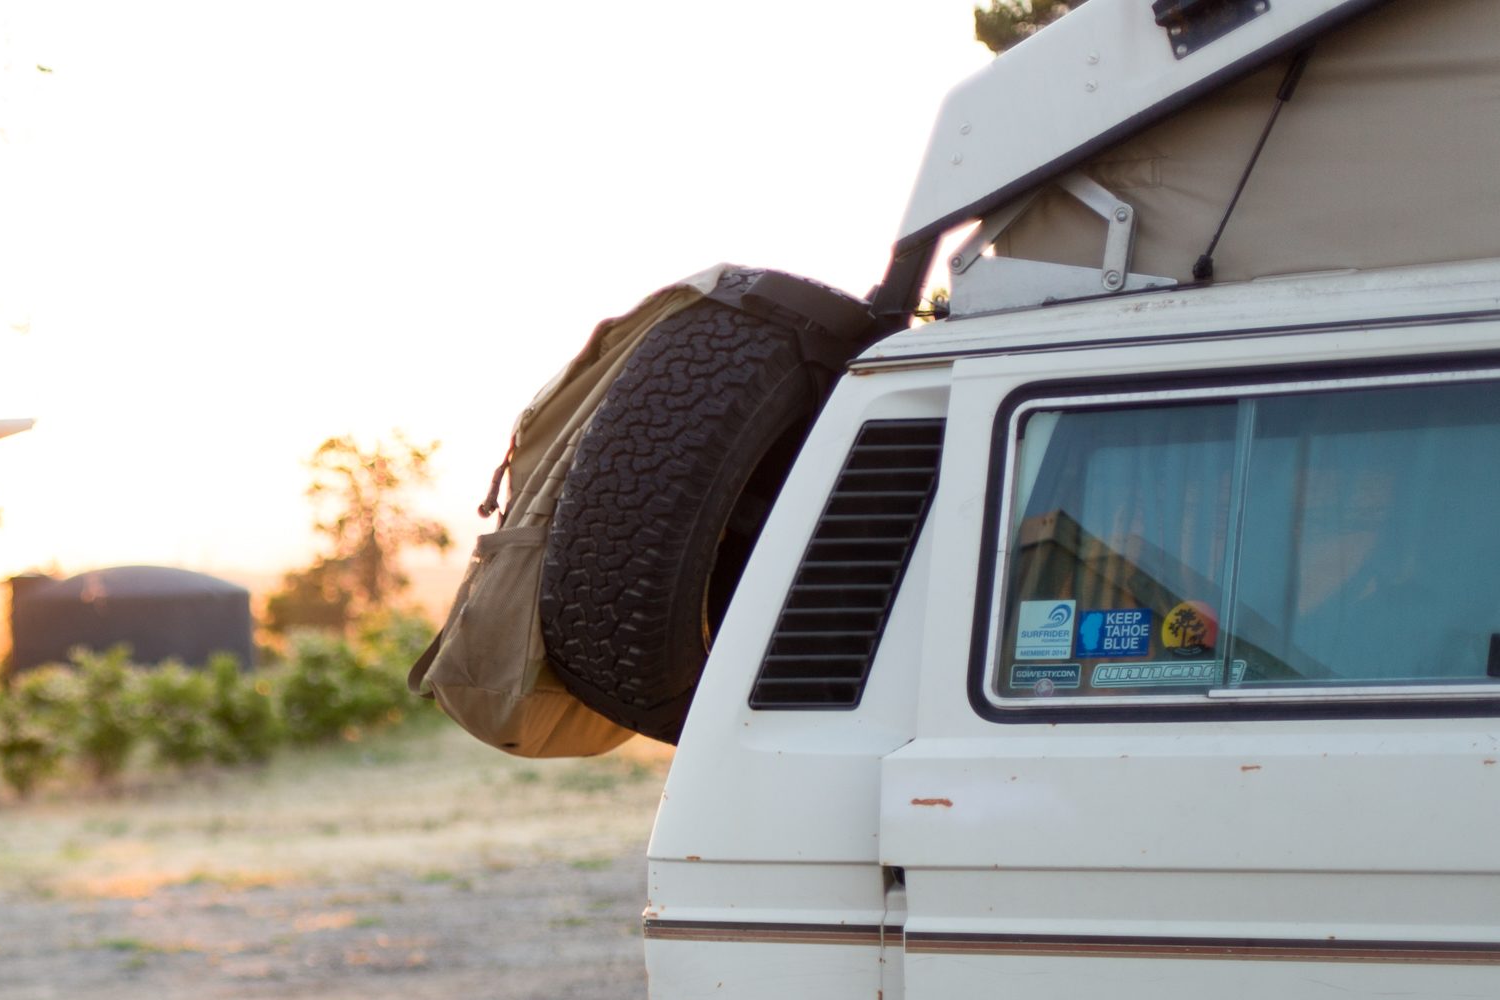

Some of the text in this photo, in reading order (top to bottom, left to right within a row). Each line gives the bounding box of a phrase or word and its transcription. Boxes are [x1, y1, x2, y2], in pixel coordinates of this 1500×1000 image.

[1106, 612, 1142, 625] KEEP
[1021, 629, 1070, 639] SURFRIDER
[1105, 624, 1149, 637] TAHOE
[1103, 637, 1140, 650] BLUE
